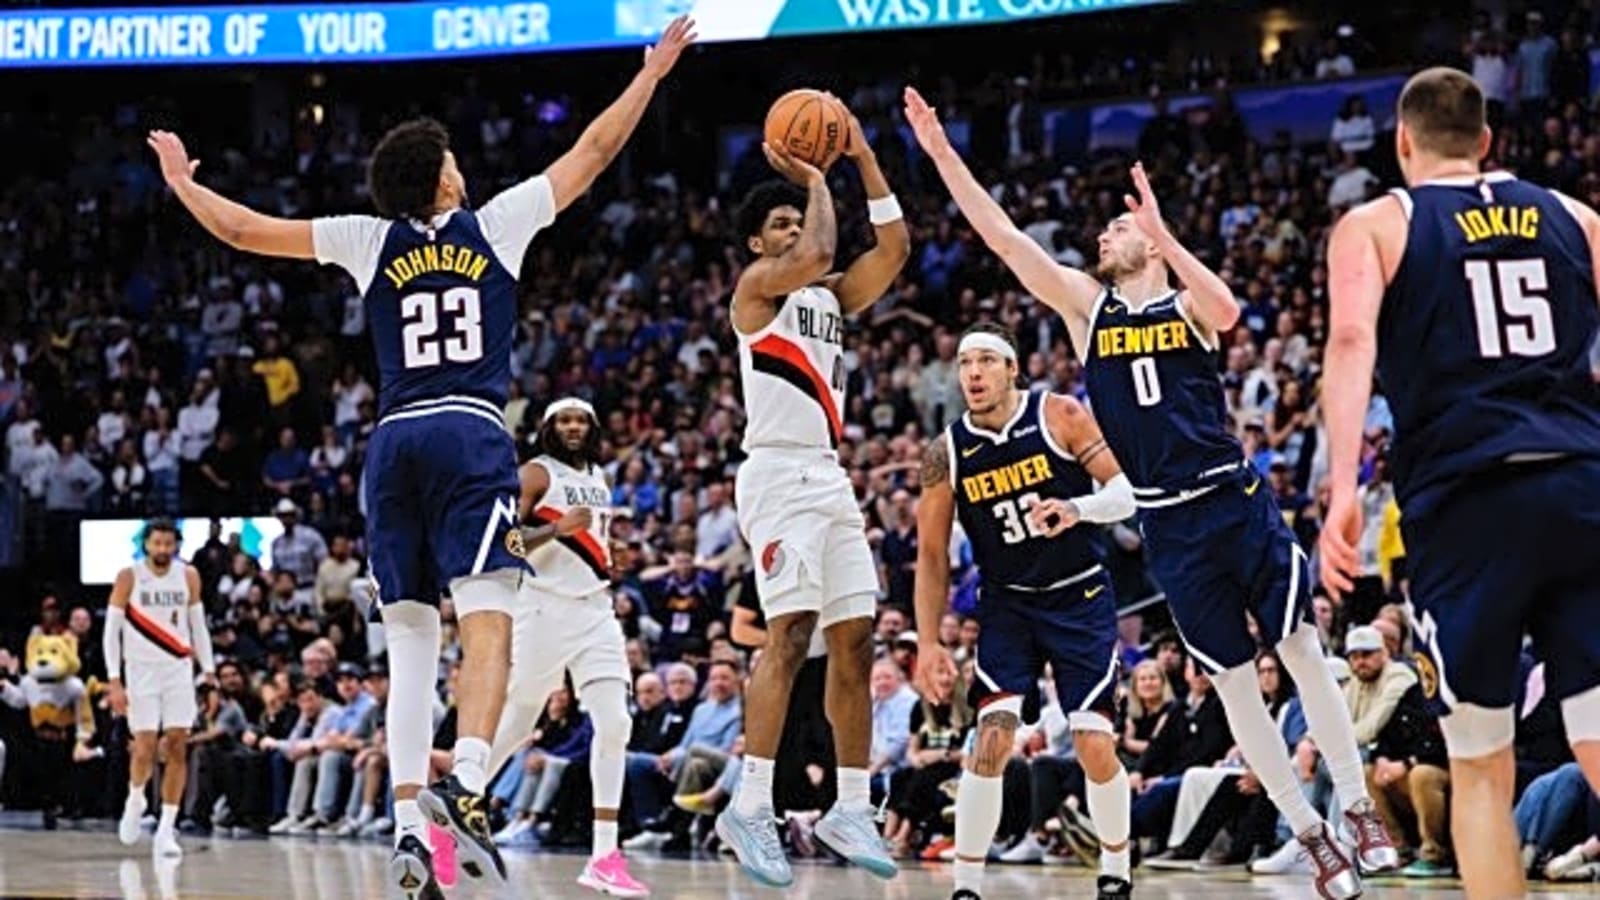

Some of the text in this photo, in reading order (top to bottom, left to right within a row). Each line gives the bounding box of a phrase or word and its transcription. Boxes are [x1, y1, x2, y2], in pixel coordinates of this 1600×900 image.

[0, 3, 551, 58] ENT PARTNER OF YOUR DENVER
[384, 244, 488, 289] JOHNSON
[401, 286, 483, 368] 23
[1464, 258, 1556, 357] 15
[1097, 321, 1189, 359] DENVER
[1131, 357, 1162, 406] 0
[962, 453, 1053, 503] DENVER
